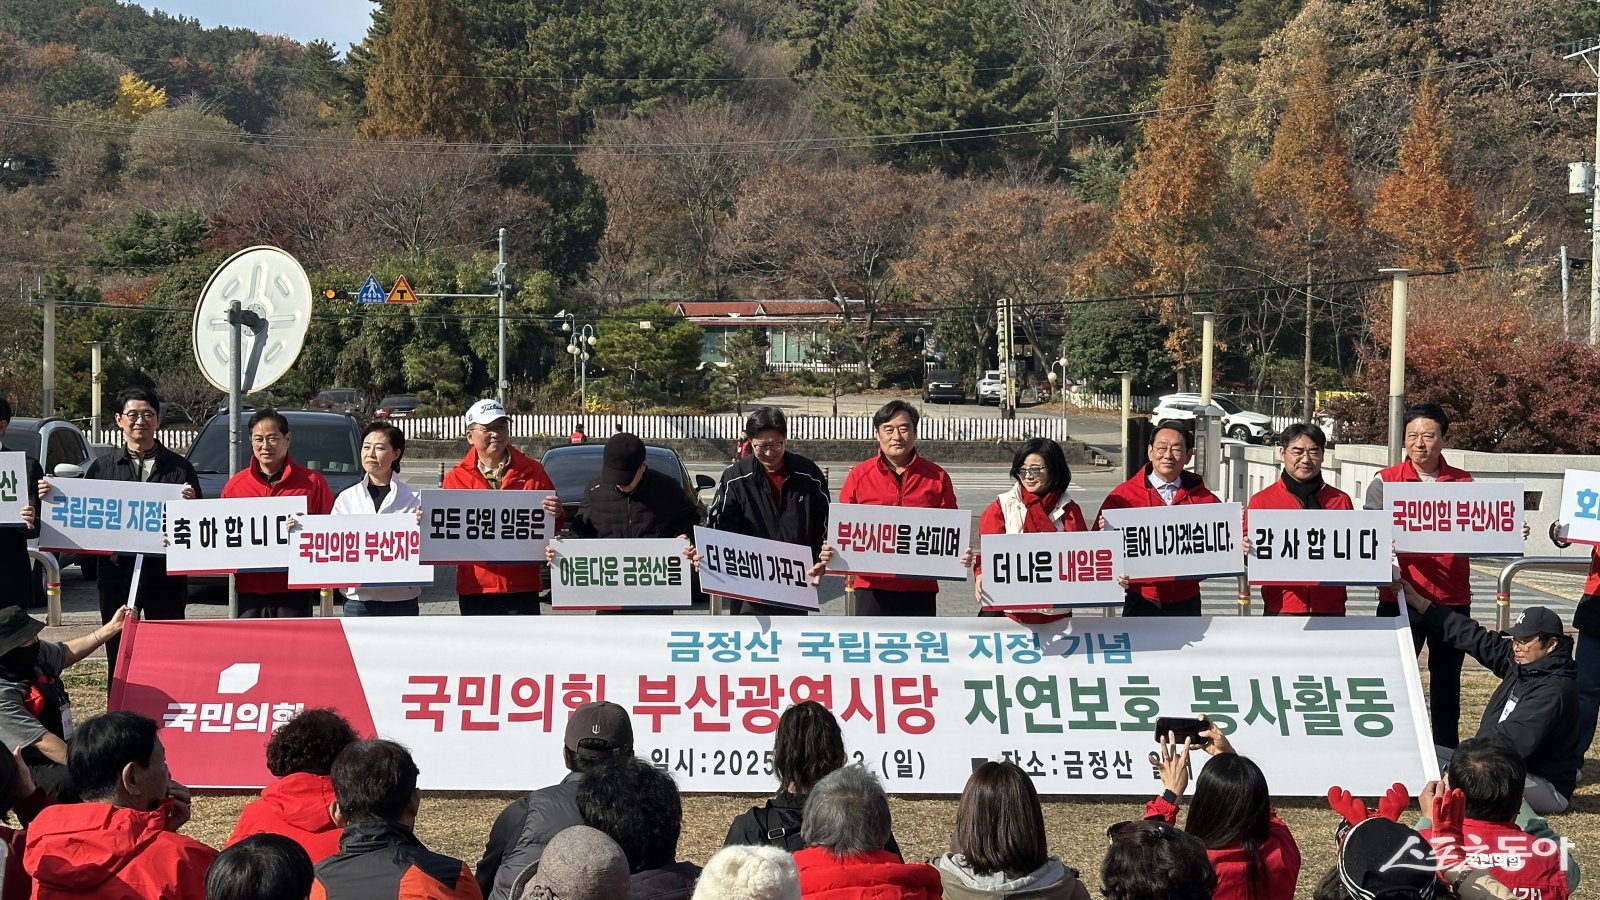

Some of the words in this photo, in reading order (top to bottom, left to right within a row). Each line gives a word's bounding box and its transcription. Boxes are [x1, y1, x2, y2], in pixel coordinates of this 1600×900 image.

[51, 495, 122, 530] 국립공원
[126, 500, 166, 533] 지정
[430, 508, 460, 540] 모든
[466, 508, 496, 540] 당원
[500, 508, 545, 540] 일동은
[1392, 500, 1451, 532] 국민의힘
[1456, 500, 1515, 532] 부산시당
[299, 531, 360, 563] 국민의힘
[837, 521, 911, 555] 부산시민을
[915, 525, 961, 557] 살피며
[1154, 521, 1234, 556] 나가겠습니다.
[1255, 527, 1379, 560] 감사합니다
[560, 556, 618, 587] 아름다운
[623, 556, 682, 586] 금정산을
[705, 544, 721, 574] 더
[723, 547, 765, 581] 열심히
[766, 555, 808, 588] 가꾸고
[993, 552, 1010, 584] 더
[1016, 551, 1053, 584] 나은
[1058, 549, 1113, 582] 내일을
[667, 630, 782, 663] 금정산
[797, 631, 950, 663] 국립공원
[968, 632, 1042, 664] 지정
[1062, 632, 1133, 664] 기념
[164, 702, 304, 733] 국민의힘
[401, 673, 605, 733] 국민의힘
[964, 675, 1161, 734] 자연보호
[1190, 675, 1396, 738] 봉사활동
